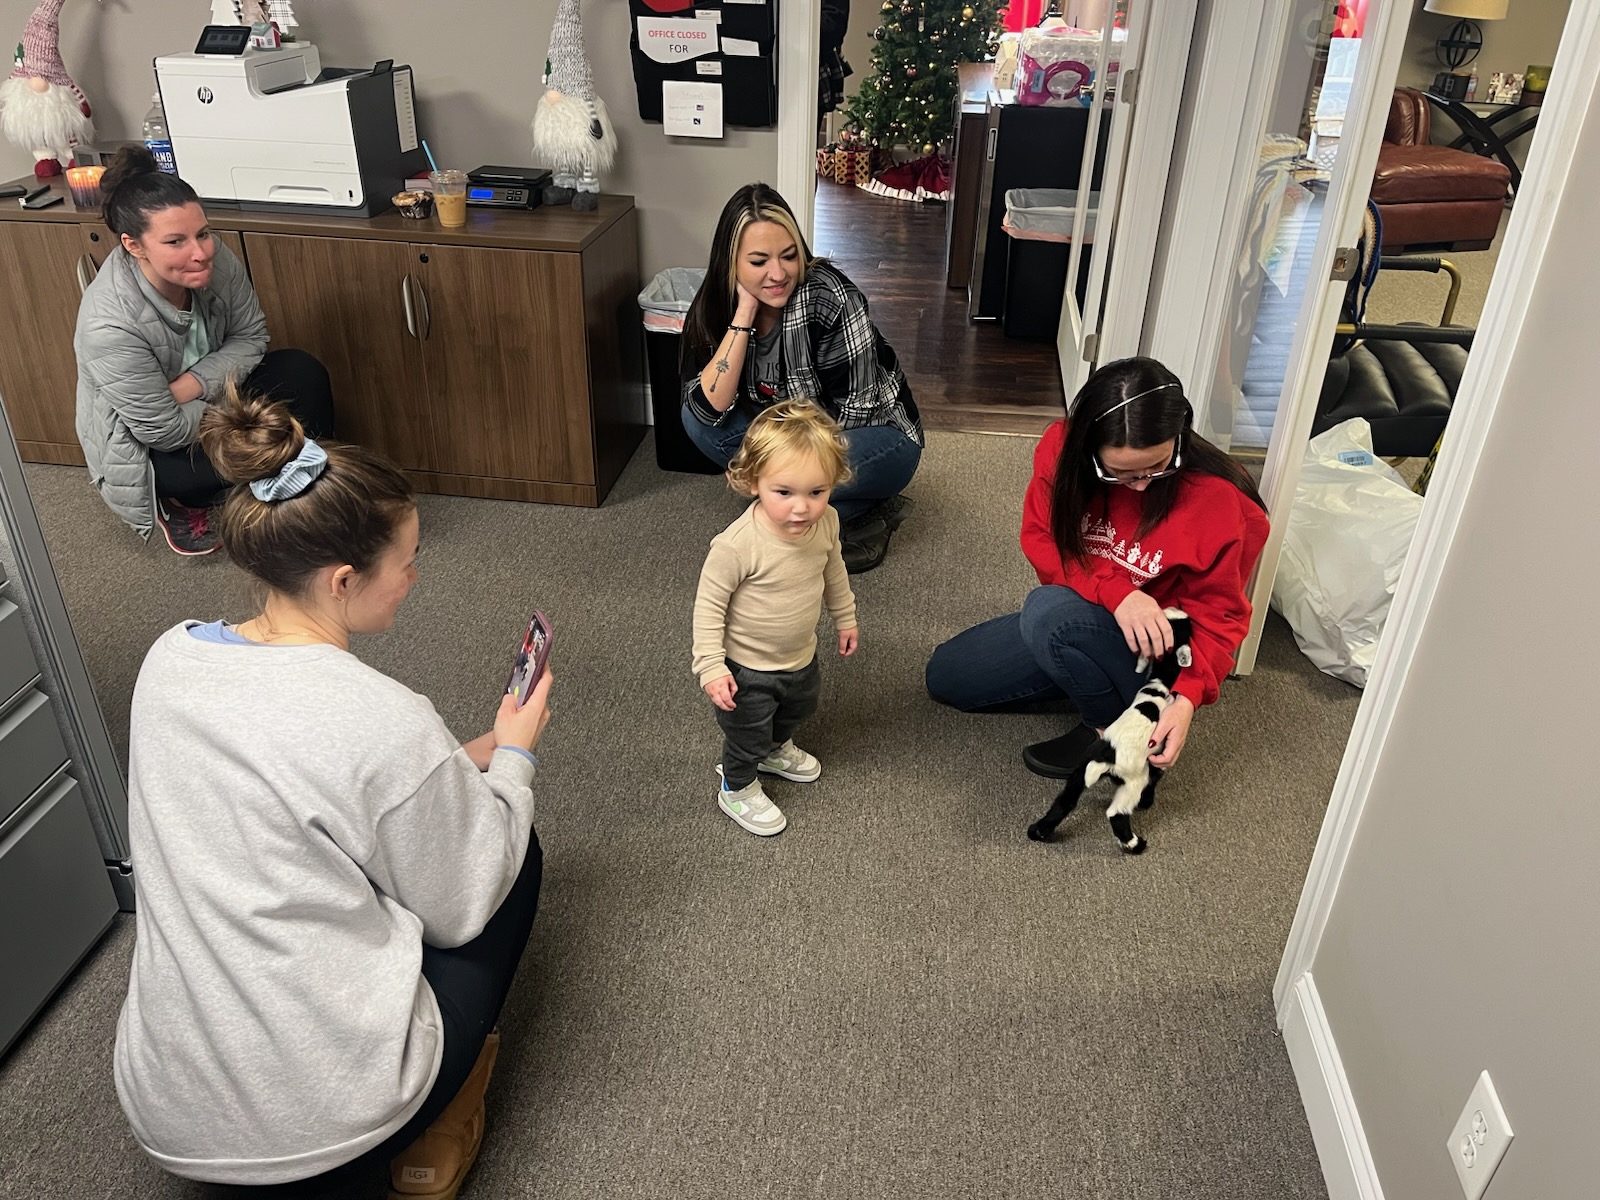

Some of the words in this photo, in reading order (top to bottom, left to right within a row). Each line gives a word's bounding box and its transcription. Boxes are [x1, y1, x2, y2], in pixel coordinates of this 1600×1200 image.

[648, 30, 675, 39] OFFICE
[677, 31, 707, 39] CLOSED
[669, 44, 689, 54] FOR
[198, 86, 212, 104] hp
